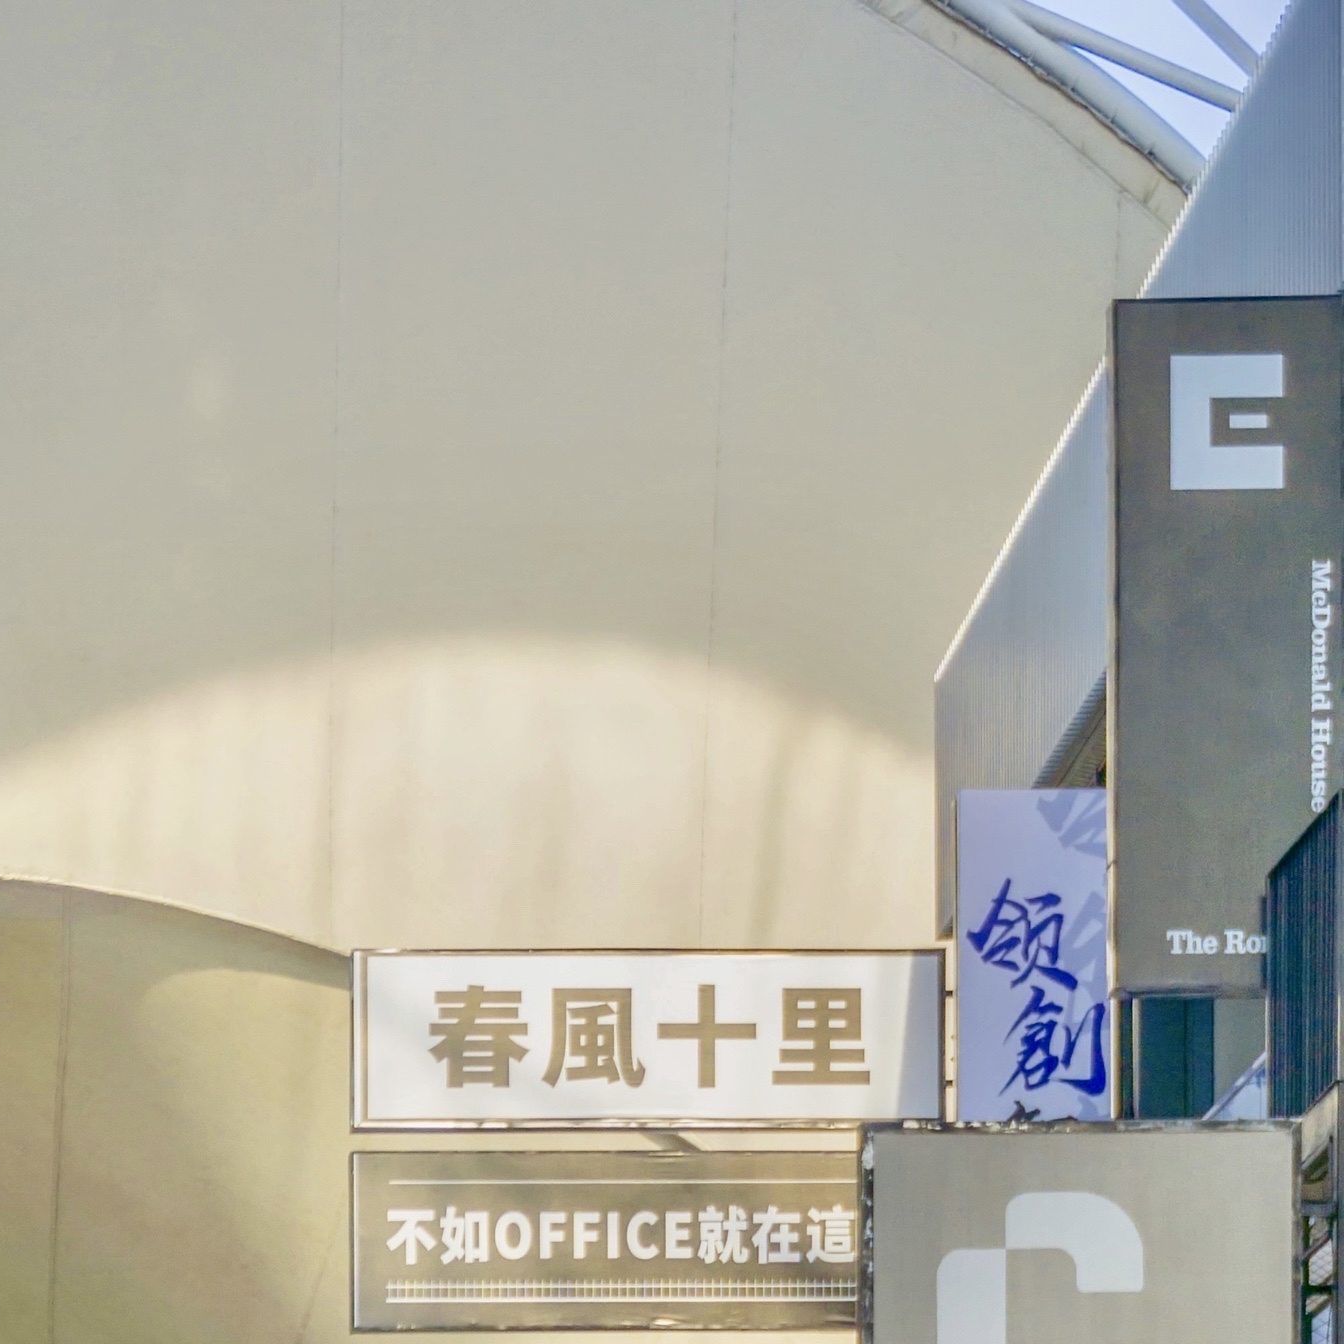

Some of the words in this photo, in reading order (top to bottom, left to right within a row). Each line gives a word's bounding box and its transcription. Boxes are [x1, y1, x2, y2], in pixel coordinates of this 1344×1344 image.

[1311, 560, 1331, 712] McDonald
[1310, 719, 1330, 813] House
[1167, 930, 1218, 954] The
[428, 984, 870, 1088] 春風十里
[386, 1205, 855, 1265] 不如OFFICE就在這
